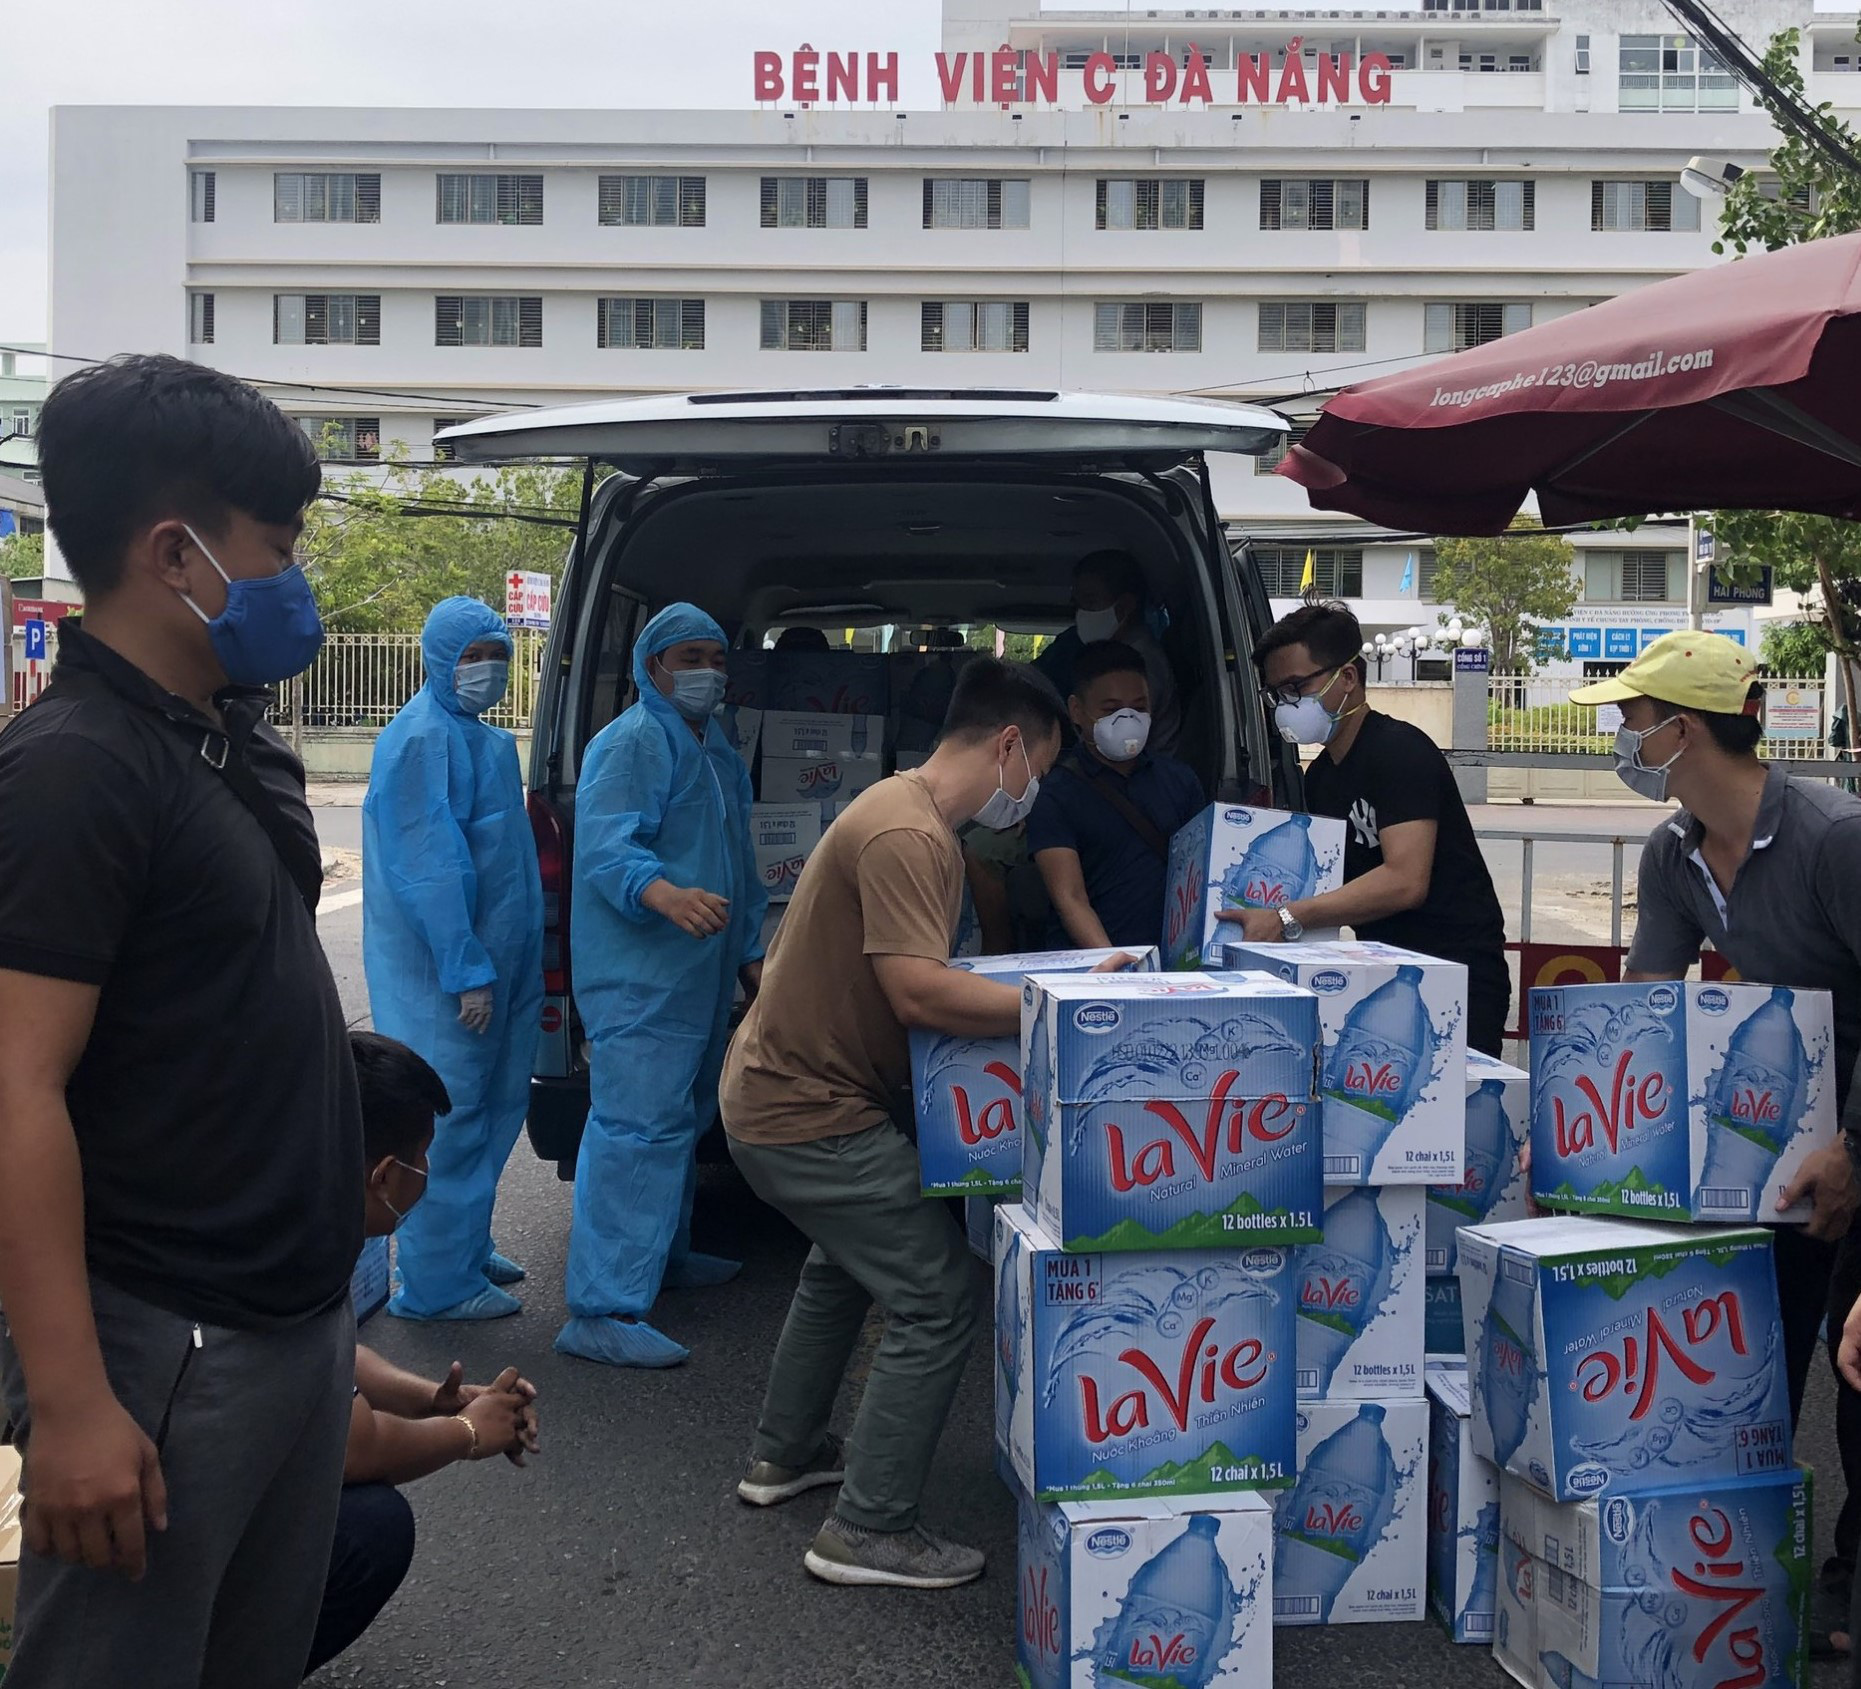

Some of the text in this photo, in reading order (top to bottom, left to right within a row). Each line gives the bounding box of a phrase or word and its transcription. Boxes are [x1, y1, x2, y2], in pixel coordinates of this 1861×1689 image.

[754, 43, 899, 110] BỆNH
[935, 43, 1059, 110] VIỆN
[1082, 51, 1117, 105] C
[1144, 42, 1214, 105] ĐÀ
[1429, 348, 1715, 407] longcaphe123@gmail.com
[31, 627, 41, 651] P
[1246, 880, 1290, 906] laVie
[1314, 975, 1345, 986] Nestlé
[1080, 1010, 1116, 1023] Nestlé
[1344, 1062, 1401, 1096] laVie
[1552, 1049, 1668, 1158] laVie
[1731, 1089, 1782, 1125] laVie
[1104, 1068, 1299, 1193] laVie
[1652, 1120, 1676, 1137] Water
[1405, 1151, 1414, 1162] 12
[1415, 1151, 1431, 1162] chai
[1432, 1154, 1438, 1162] x
[1439, 1151, 1450, 1163] 1,5
[1149, 1139, 1309, 1202] Natural Mineral Water
[1621, 1188, 1681, 1209] 12 bottles x 1,5 L
[1221, 1211, 1314, 1230] 12 bottles x 1.5 L
[1047, 1259, 1091, 1279] MUA 1
[1245, 1254, 1279, 1267] Nestlé
[1553, 1257, 1638, 1281] 12 bottles x 1,5 L
[1048, 1279, 1084, 1305] TẶNG
[1301, 1277, 1360, 1310] laVie
[1562, 1284, 1705, 1356] Natural Mineral Water
[1576, 1290, 1748, 1422] laVie
[1077, 1316, 1268, 1443] laVie
[1353, 1364, 1416, 1377] 12 bottles x 1,5 L
[1091, 1395, 1267, 1464] Nước Khoáng Thiên Nhiên
[1747, 1448, 1785, 1469] MUA 1
[1210, 1462, 1284, 1482] 12 chai x 1,5 L
[1070, 1483, 1091, 1493] thùng
[1111, 1481, 1129, 1490] Tặng
[1137, 1480, 1152, 1488] chai
[1304, 1503, 1364, 1535] laVie
[1613, 1502, 1624, 1538] Nestlé
[1738, 1506, 1754, 1544] Nhiên
[1795, 1508, 1805, 1517] x
[1090, 1533, 1127, 1548] Nestlé
[1793, 1518, 1805, 1544] chai
[1748, 1546, 1765, 1581] Thiên
[1794, 1545, 1805, 1559] 12
[1366, 1587, 1417, 1601] 12 chai x 1,5 L
[1761, 1598, 1775, 1645] Khoáng
[1128, 1634, 1197, 1672] laVie
